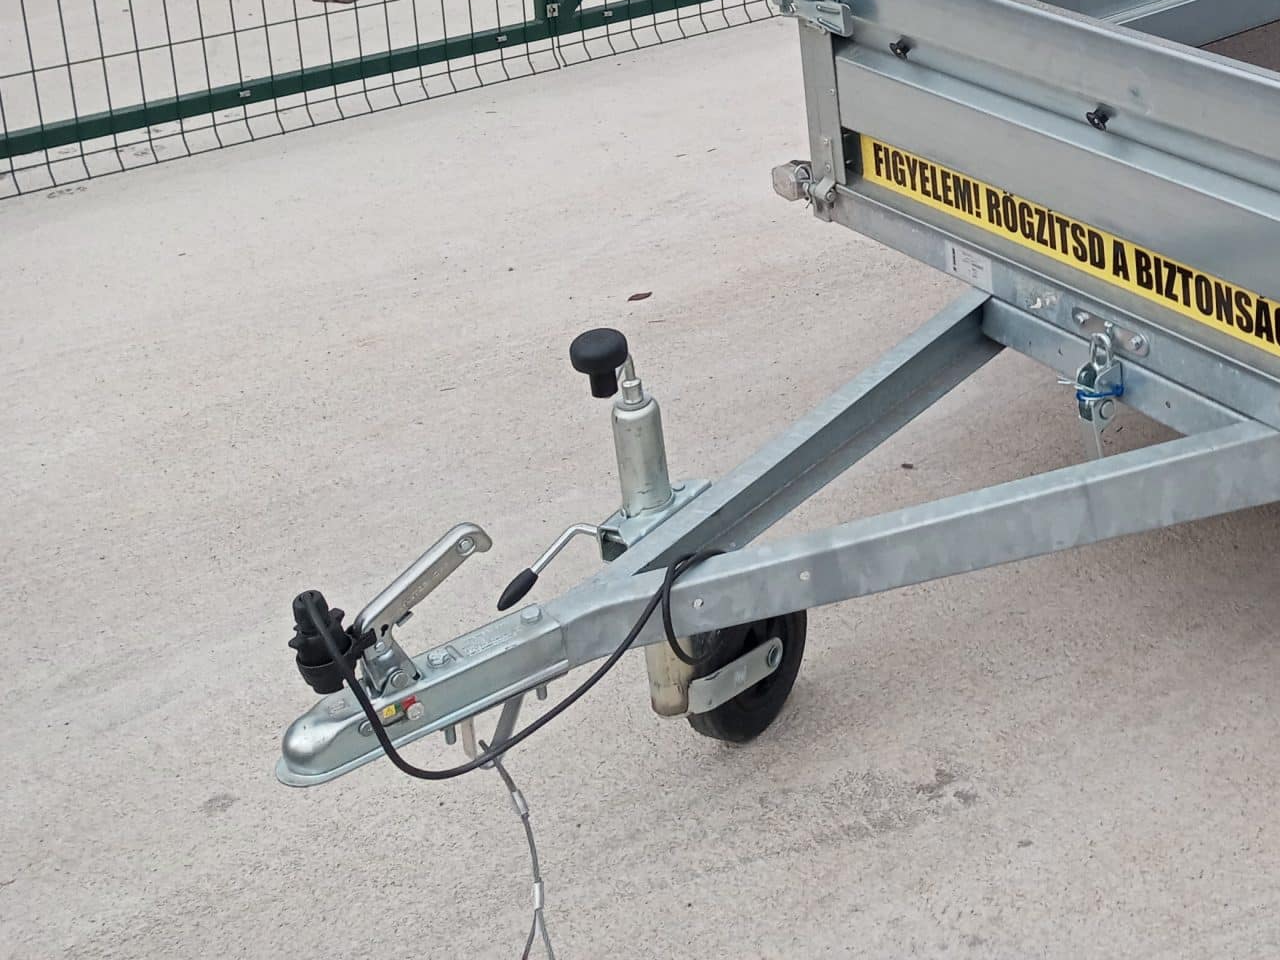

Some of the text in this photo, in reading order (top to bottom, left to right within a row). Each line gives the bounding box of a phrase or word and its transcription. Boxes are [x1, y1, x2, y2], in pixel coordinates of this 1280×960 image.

[872, 142, 982, 220] FIGYELEM!
[985, 188, 1106, 270] RÖGZÍTSD
[1112, 239, 1131, 282] A
